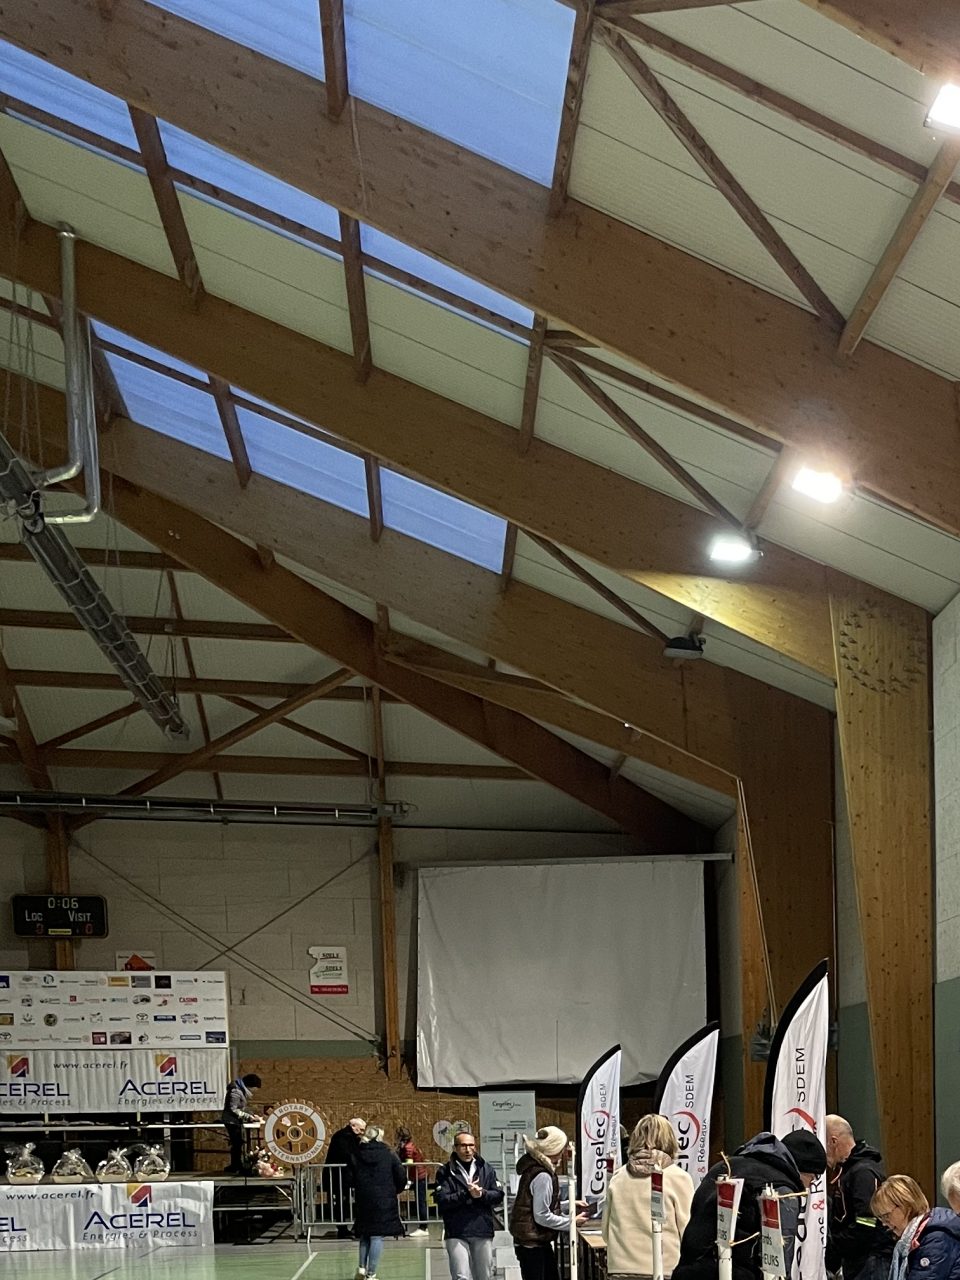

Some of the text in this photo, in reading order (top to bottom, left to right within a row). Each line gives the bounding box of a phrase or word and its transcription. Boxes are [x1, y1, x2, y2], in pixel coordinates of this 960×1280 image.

[53, 1060, 129, 1070] www.acerel.fr
[795, 1048, 806, 1102] SDEM
[119, 1079, 216, 1096] ACEREL
[685, 1074, 694, 1109] SDEM
[118, 1097, 162, 1107] Energies
[179, 1096, 217, 1104] Process
[279, 1105, 308, 1113] ROTARY
[697, 1119, 707, 1163] Réseaux
[271, 1144, 321, 1161] INTERNATIONAL
[590, 1117, 607, 1195] Cegelec
[6, 1190, 95, 1200] www.acerel.fr
[84, 1211, 196, 1230] ACEREL
[83, 1231, 134, 1241] Energies
[153, 1229, 198, 1238] Process
